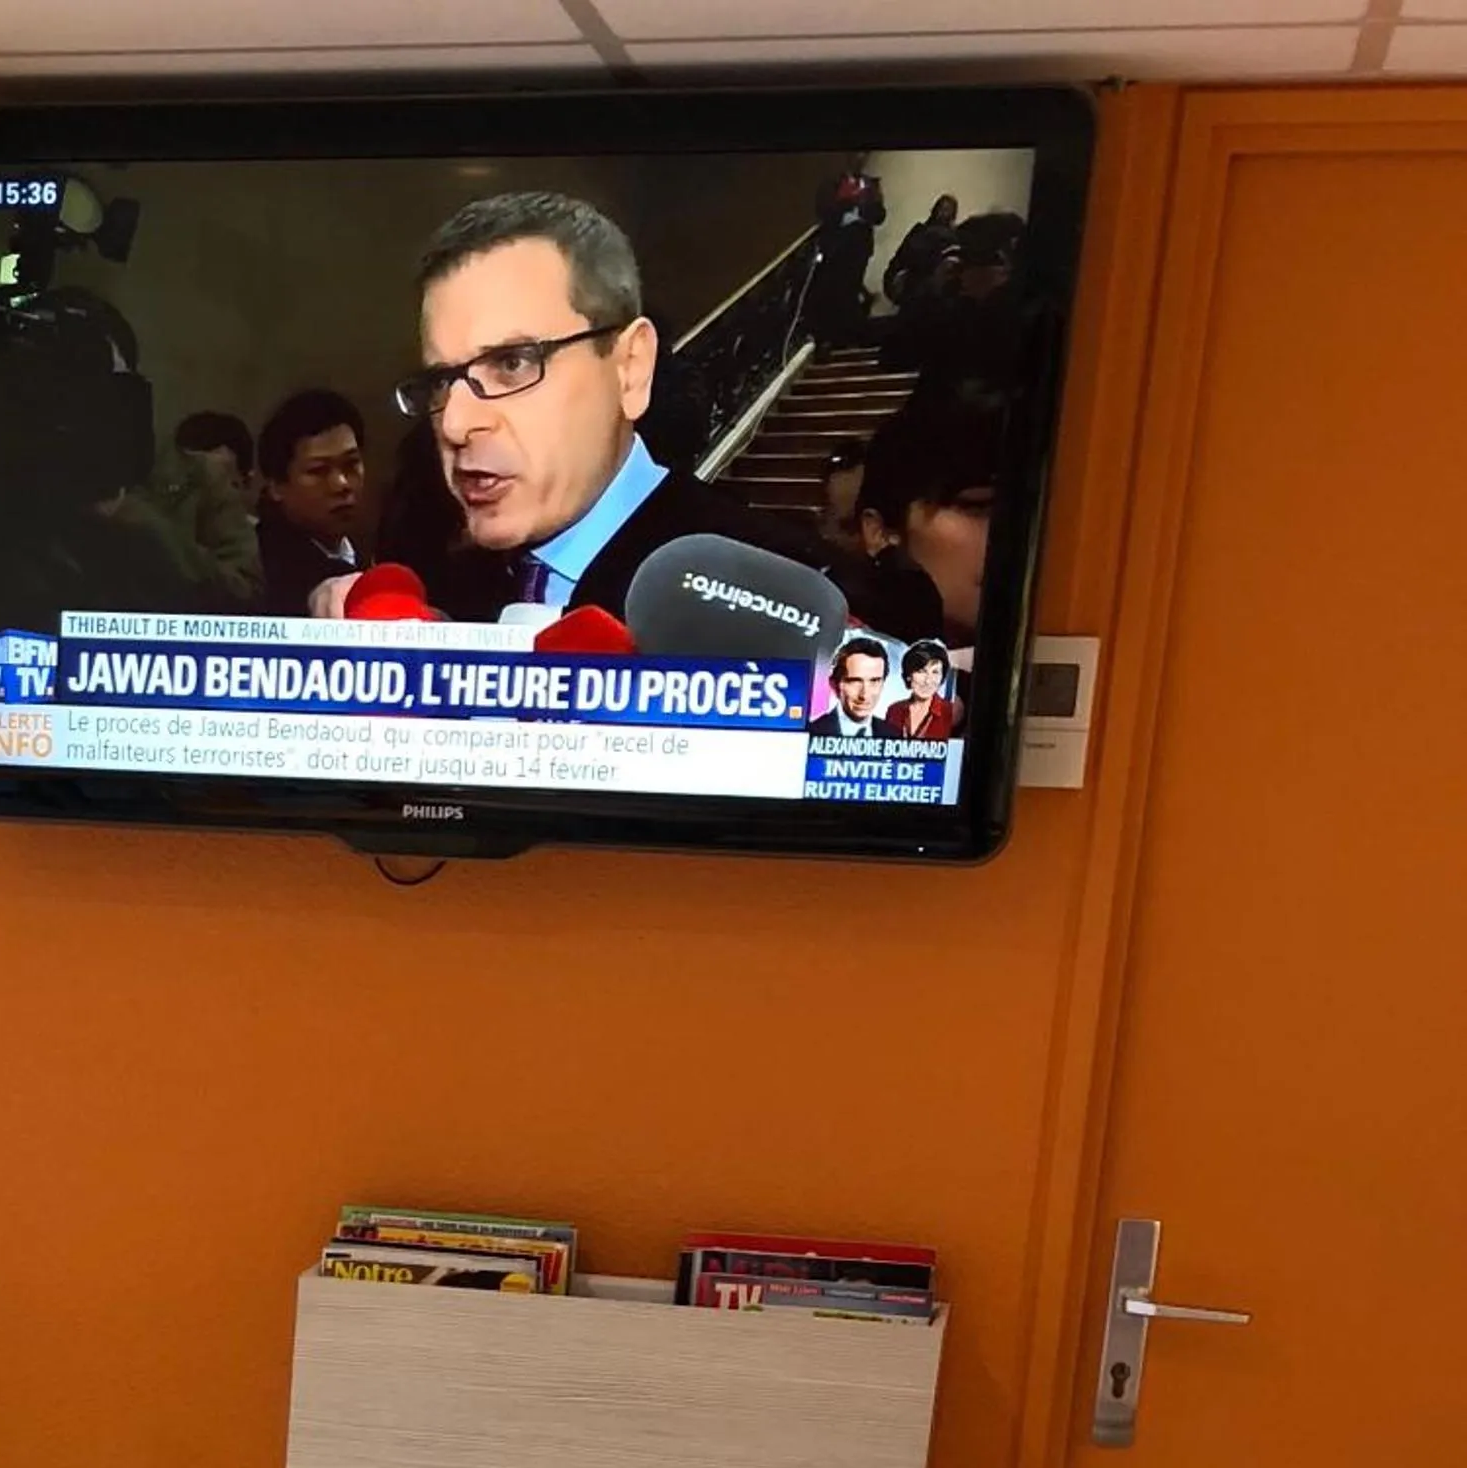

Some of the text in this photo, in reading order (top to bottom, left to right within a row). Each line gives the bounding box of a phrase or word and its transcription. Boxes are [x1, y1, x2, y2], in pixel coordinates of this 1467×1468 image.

[681, 572, 821, 638] franceinfo:
[67, 615, 289, 639] THIBAULT DE MONTBRIAL
[8, 636, 58, 666] BFM
[68, 651, 197, 696] JAWAD
[204, 656, 415, 709] BENDAOUD,
[421, 662, 571, 709] L'HEURE
[577, 667, 631, 712] DU
[68, 710, 89, 732] Le
[168, 714, 193, 737] de
[198, 716, 259, 739] Jawad
[383, 727, 414, 749] qu
[537, 733, 588, 757] pour
[662, 734, 690, 755] de
[66, 739, 176, 764] malfaiteurs
[307, 748, 348, 771] doit
[356, 750, 413, 773] durer
[516, 757, 541, 778] 14
[809, 736, 948, 761] ALEXANDRE BOMPARD
[824, 759, 924, 781] INVITÉ DE
[805, 781, 942, 804] RUTH ELKRIEF
[402, 804, 464, 819] PHILIPS
[334, 1260, 414, 1283] Notre
[715, 1282, 763, 1312] TV
